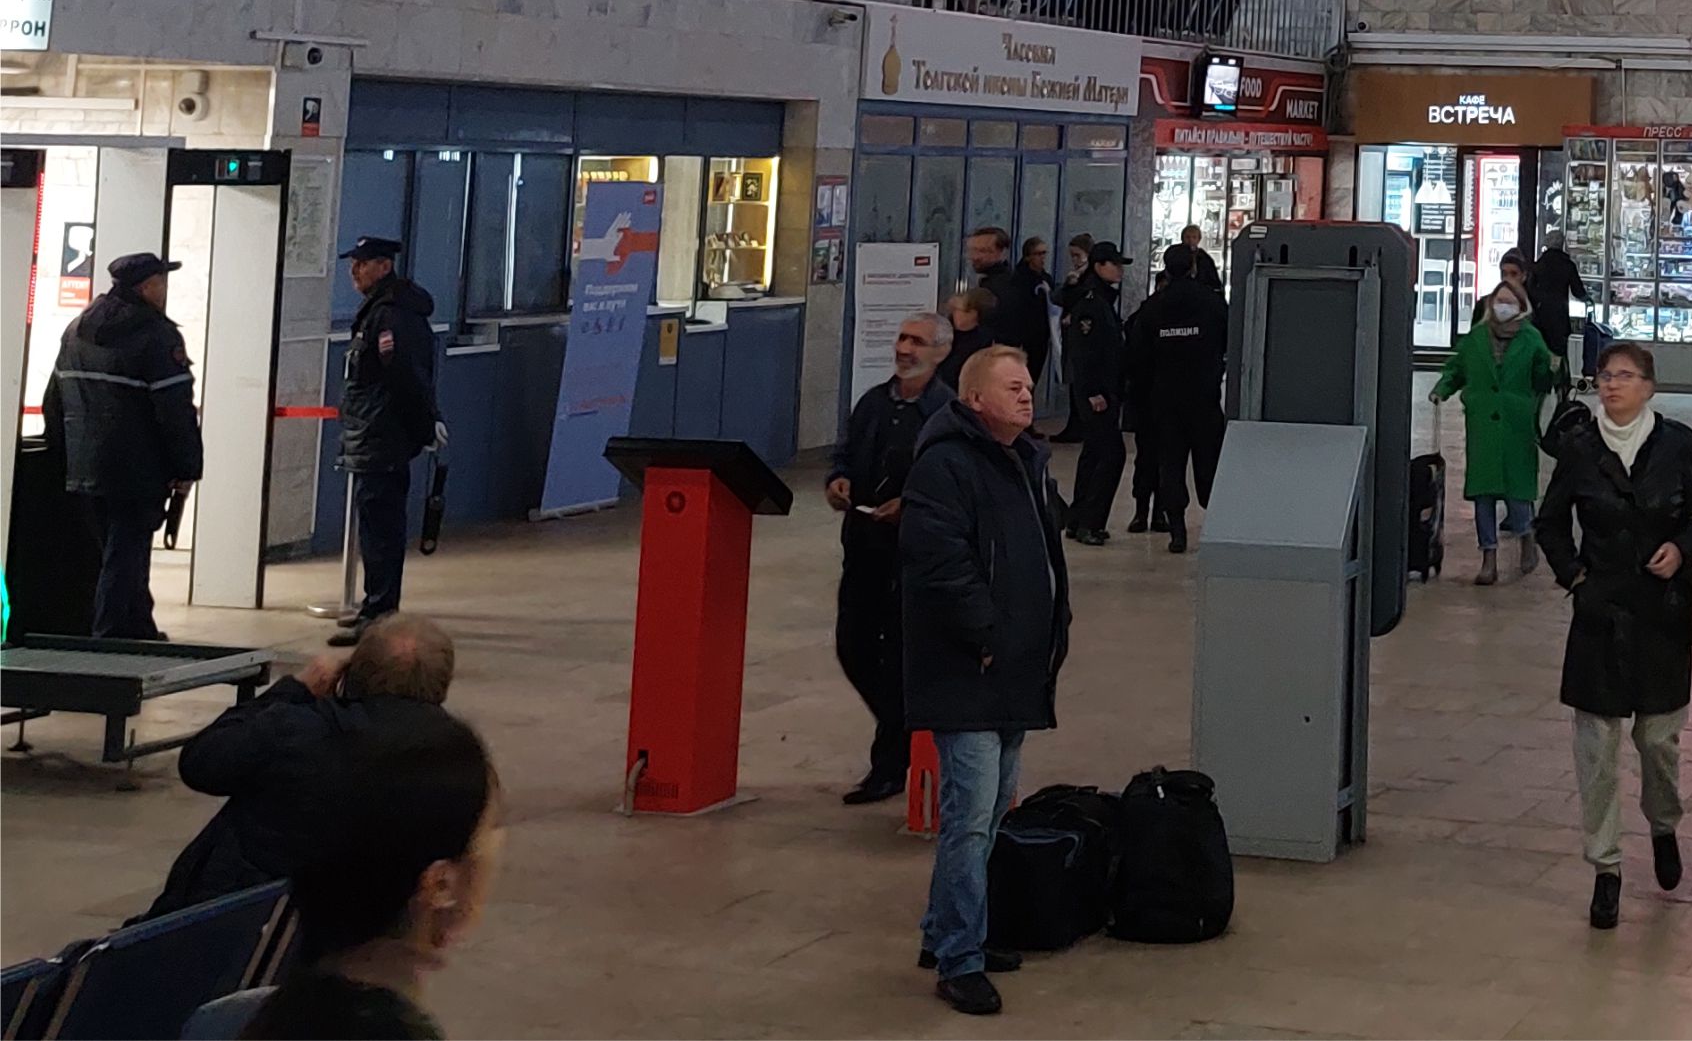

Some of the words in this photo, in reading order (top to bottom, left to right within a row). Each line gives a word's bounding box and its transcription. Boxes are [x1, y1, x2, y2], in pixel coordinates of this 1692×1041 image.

[1239, 76, 1262, 98] FOOD
[1285, 98, 1319, 120] MARKET
[1459, 94, 1486, 105] КАФЕ
[1428, 105, 1516, 125] ВСТРЕЧА
[1174, 125, 1206, 144] ПИТАЙСЯ
[1643, 126, 1683, 138] ПРЕСС
[1160, 326, 1199, 337] ПОЛИЦИЯ
